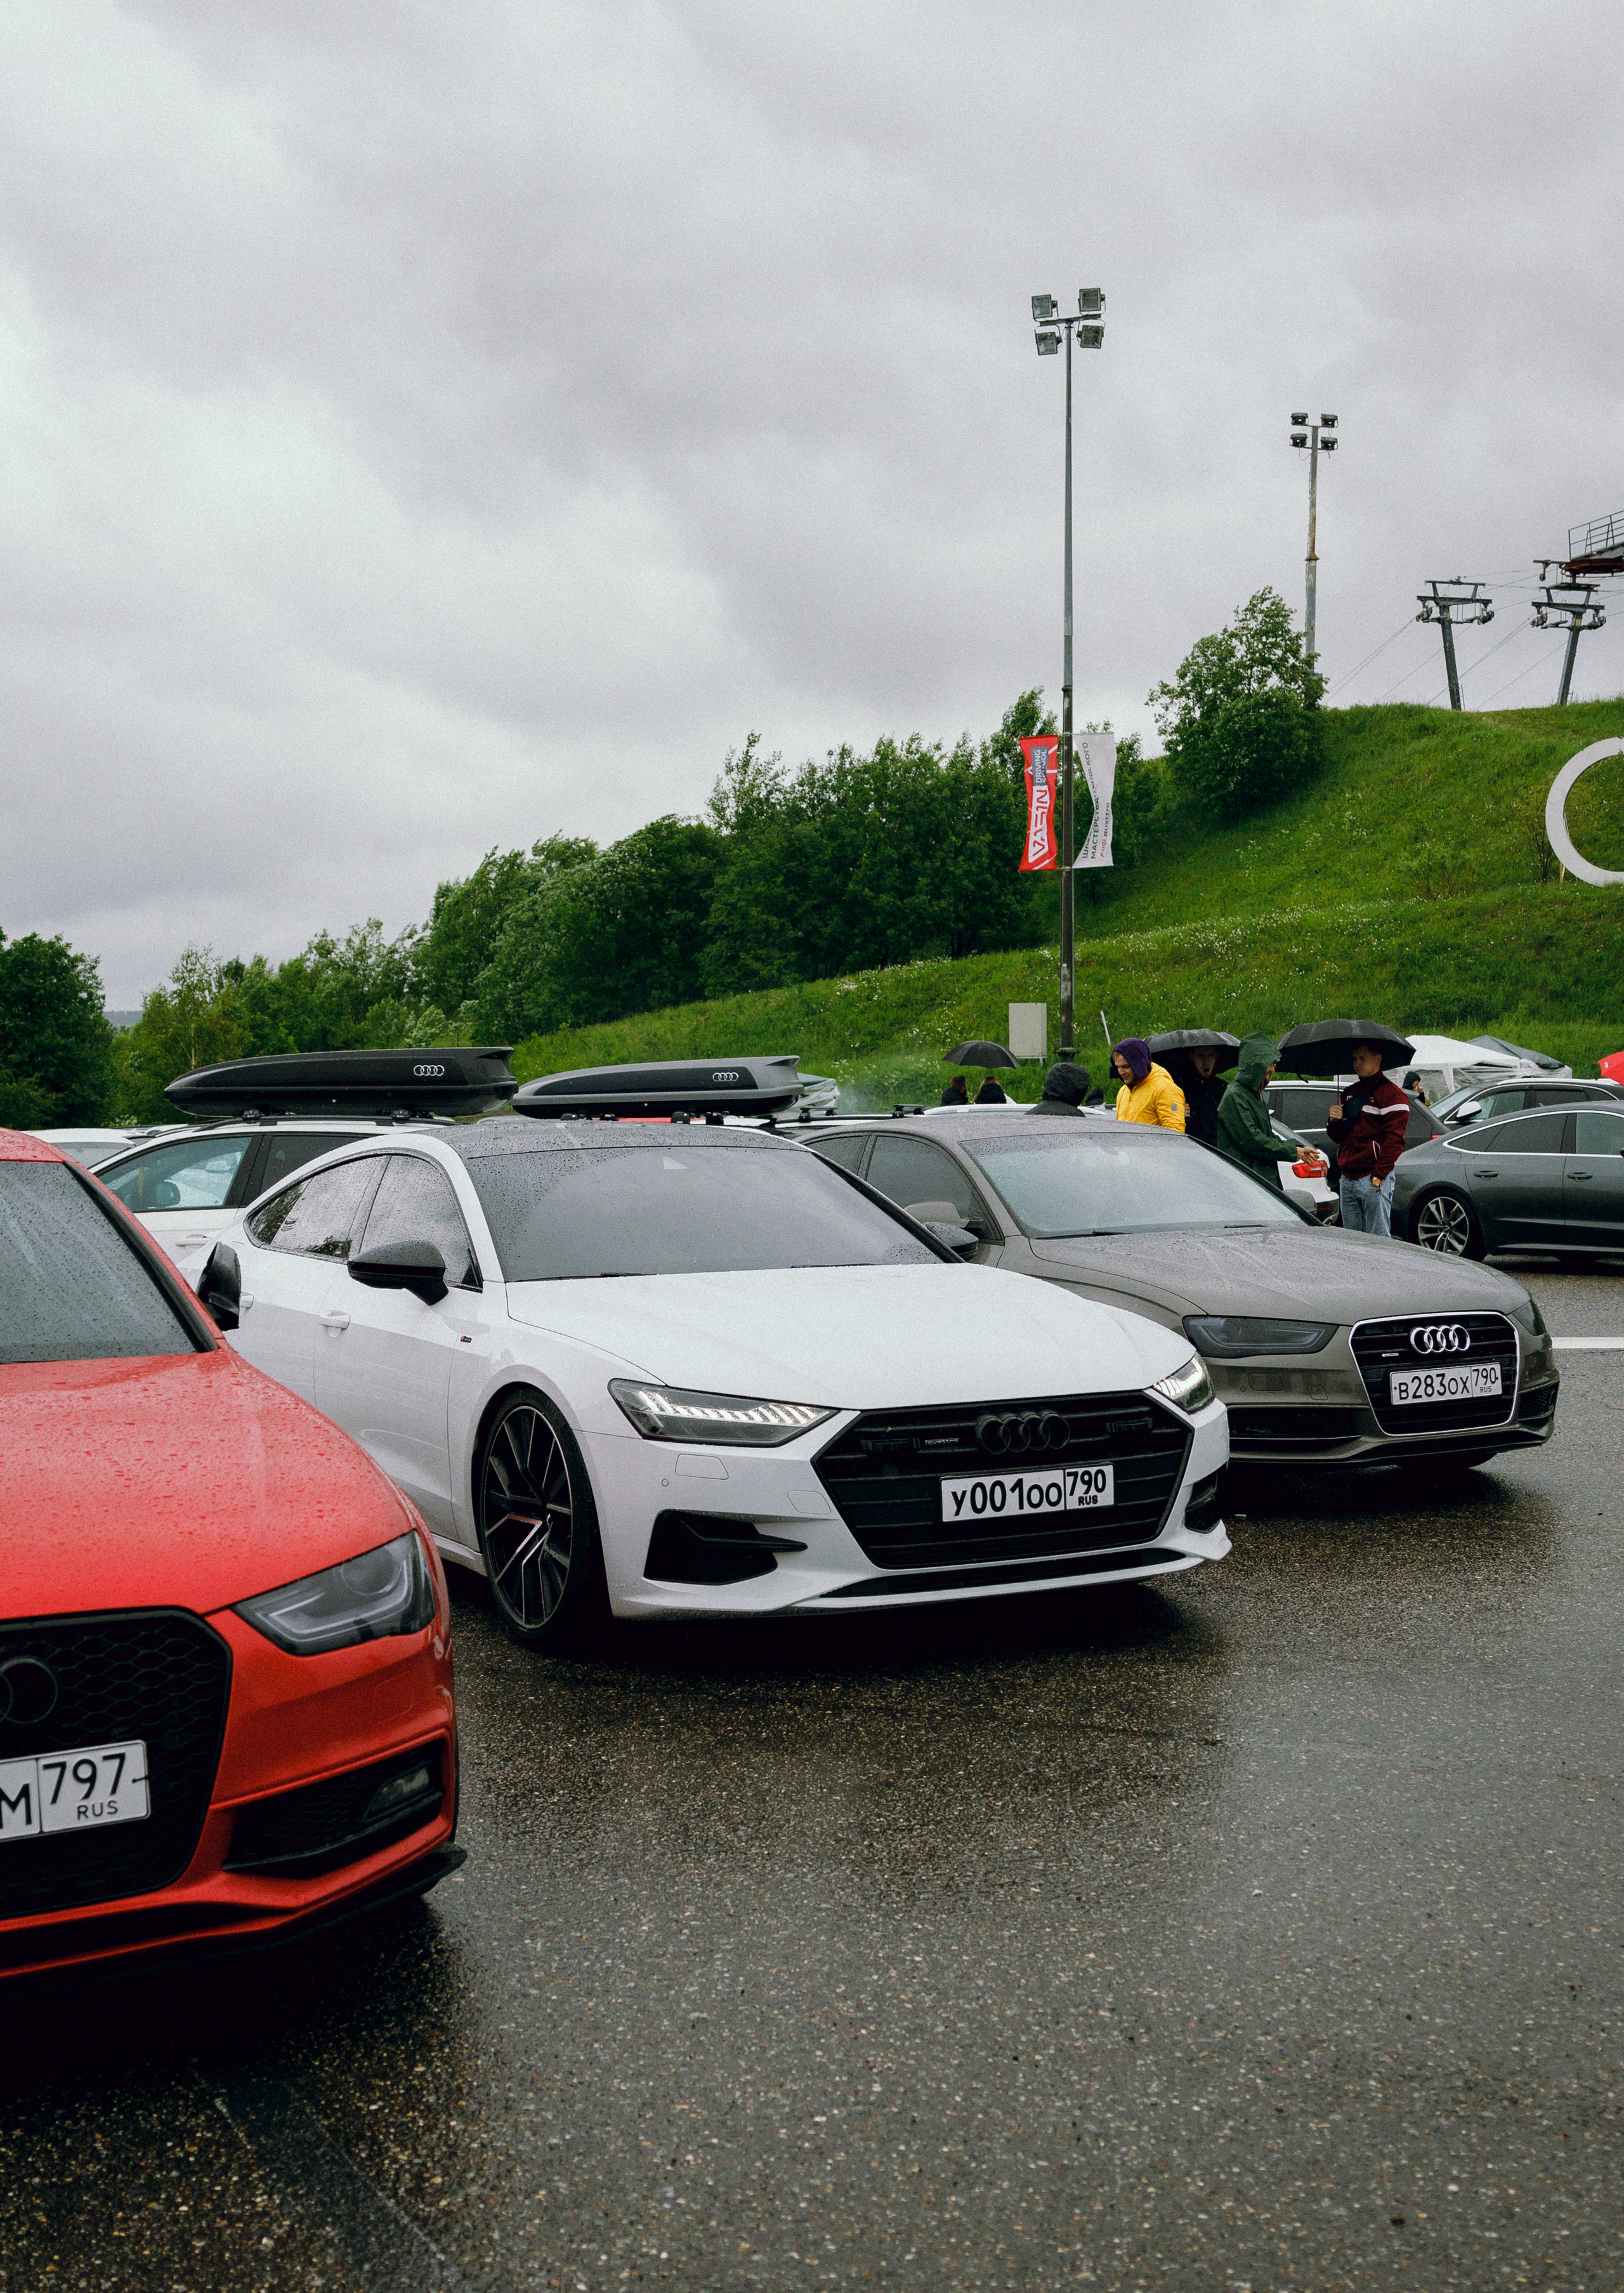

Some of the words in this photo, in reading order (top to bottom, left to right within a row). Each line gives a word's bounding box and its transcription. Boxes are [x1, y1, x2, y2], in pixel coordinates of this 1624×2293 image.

[1472, 1367, 1496, 1386] 790
[1480, 1385, 1492, 1394] RUS
[1066, 1468, 1107, 1497] 790
[1078, 1494, 1099, 1506] RUS
[42, 1752, 126, 1805] 797
[77, 1800, 119, 1820] RUS
